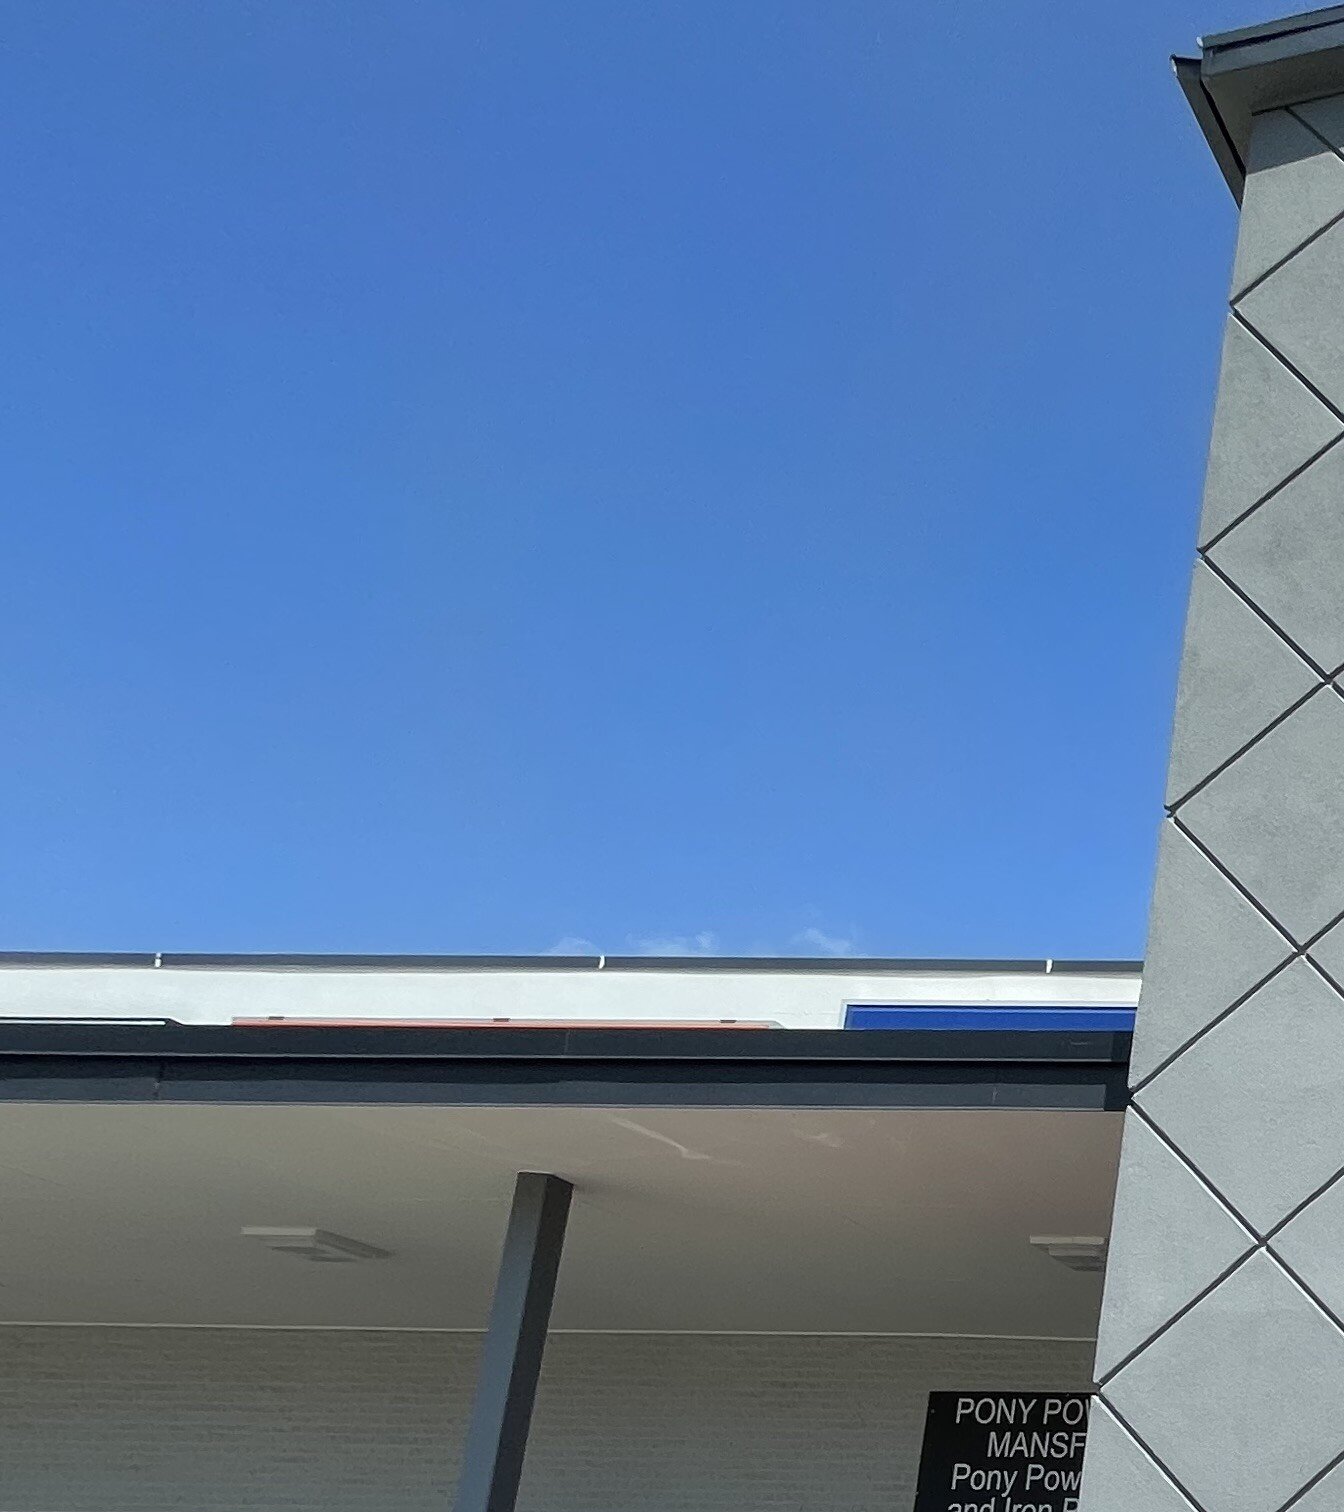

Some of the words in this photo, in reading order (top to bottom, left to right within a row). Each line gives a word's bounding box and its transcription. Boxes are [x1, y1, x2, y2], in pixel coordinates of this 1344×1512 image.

[955, 1397, 1037, 1425] PONY
[1042, 1397, 1092, 1426] PO
[950, 1462, 1019, 1498] Pony
